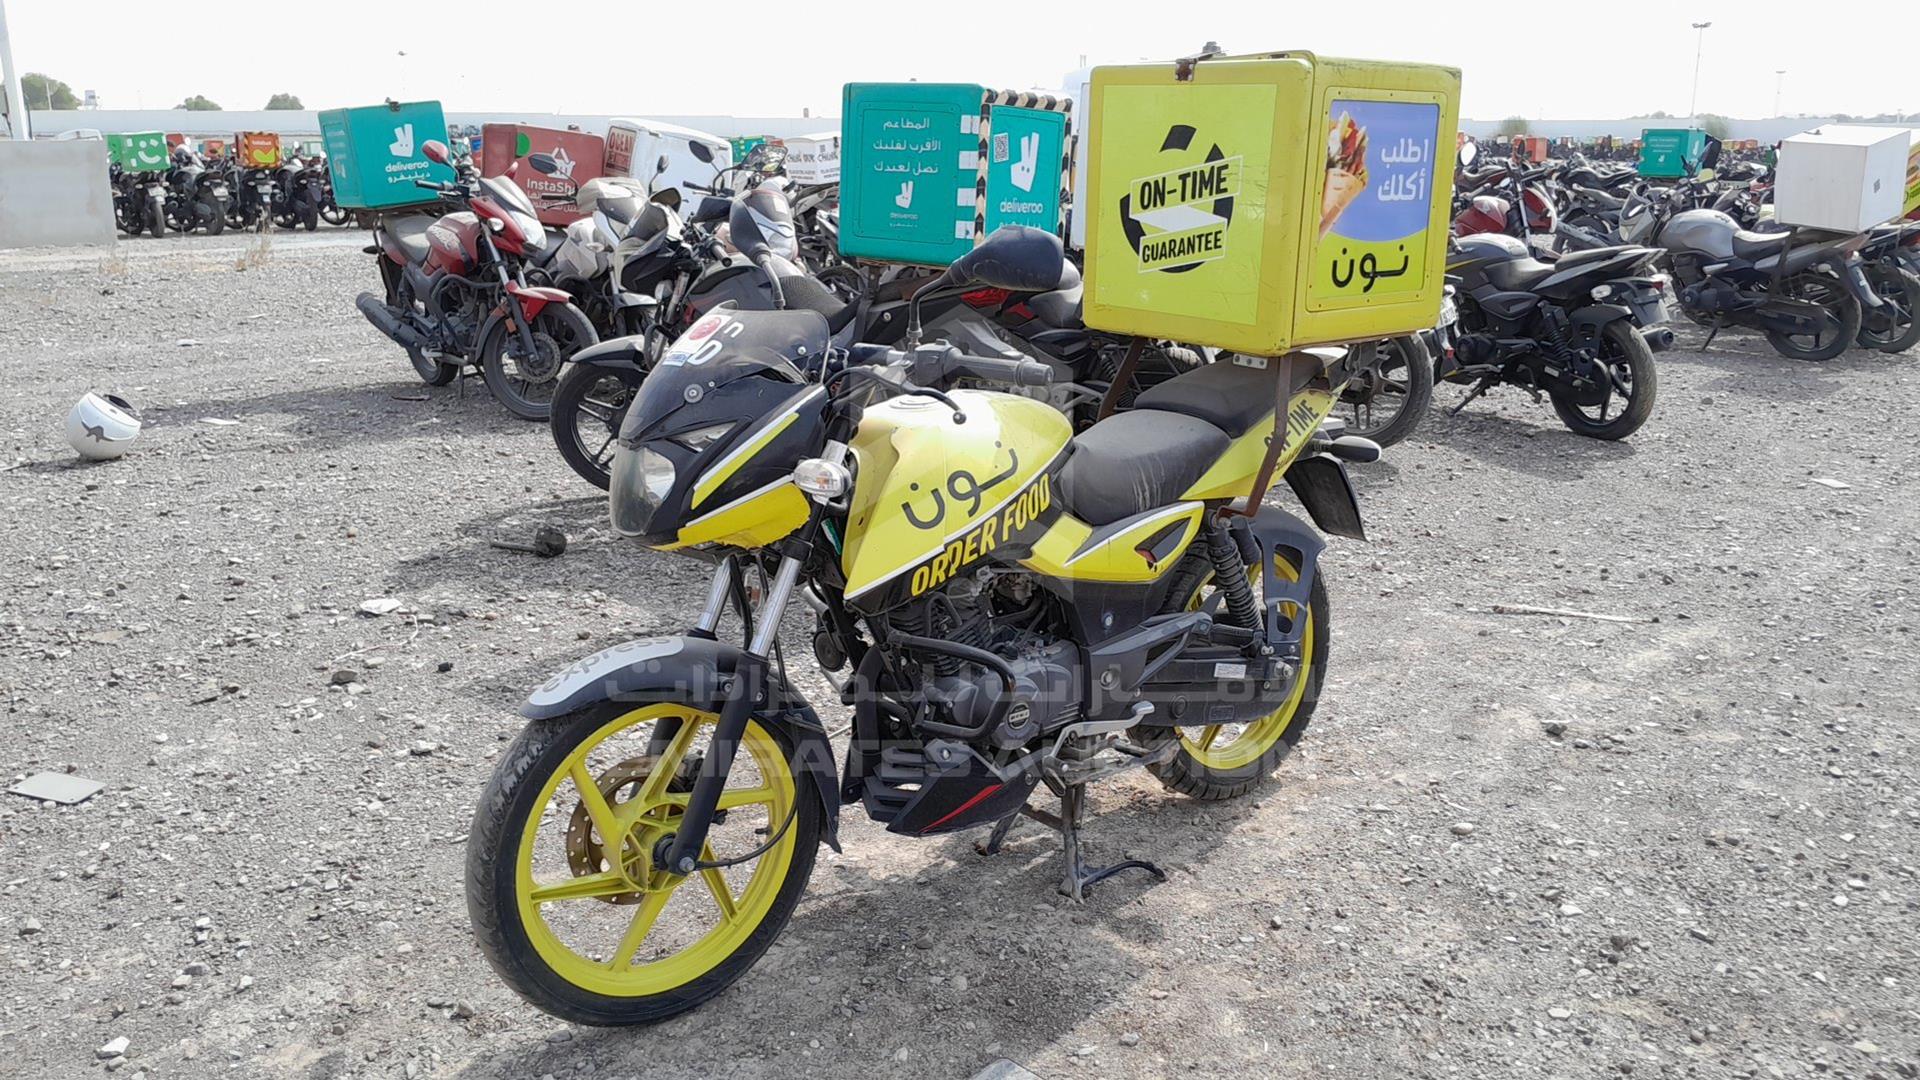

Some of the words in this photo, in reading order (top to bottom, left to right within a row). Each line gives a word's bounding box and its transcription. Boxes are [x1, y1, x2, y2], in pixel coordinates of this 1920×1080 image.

[883, 117, 930, 131] المطاعم
[909, 136, 941, 154] الأقرب
[1380, 138, 1429, 169] اطلب
[385, 161, 429, 173] deliveroo
[1140, 164, 1229, 210] ON-TIME
[1377, 167, 1426, 202] أكلك
[1000, 197, 1043, 214] deliveroo
[1142, 230, 1223, 263] GUARANTEE
[1331, 244, 1409, 293] نون
[902, 440, 1018, 529] نون
[911, 516, 998, 597] ORDER
[1002, 473, 1051, 542] FOOD
[542, 636, 671, 693] express
